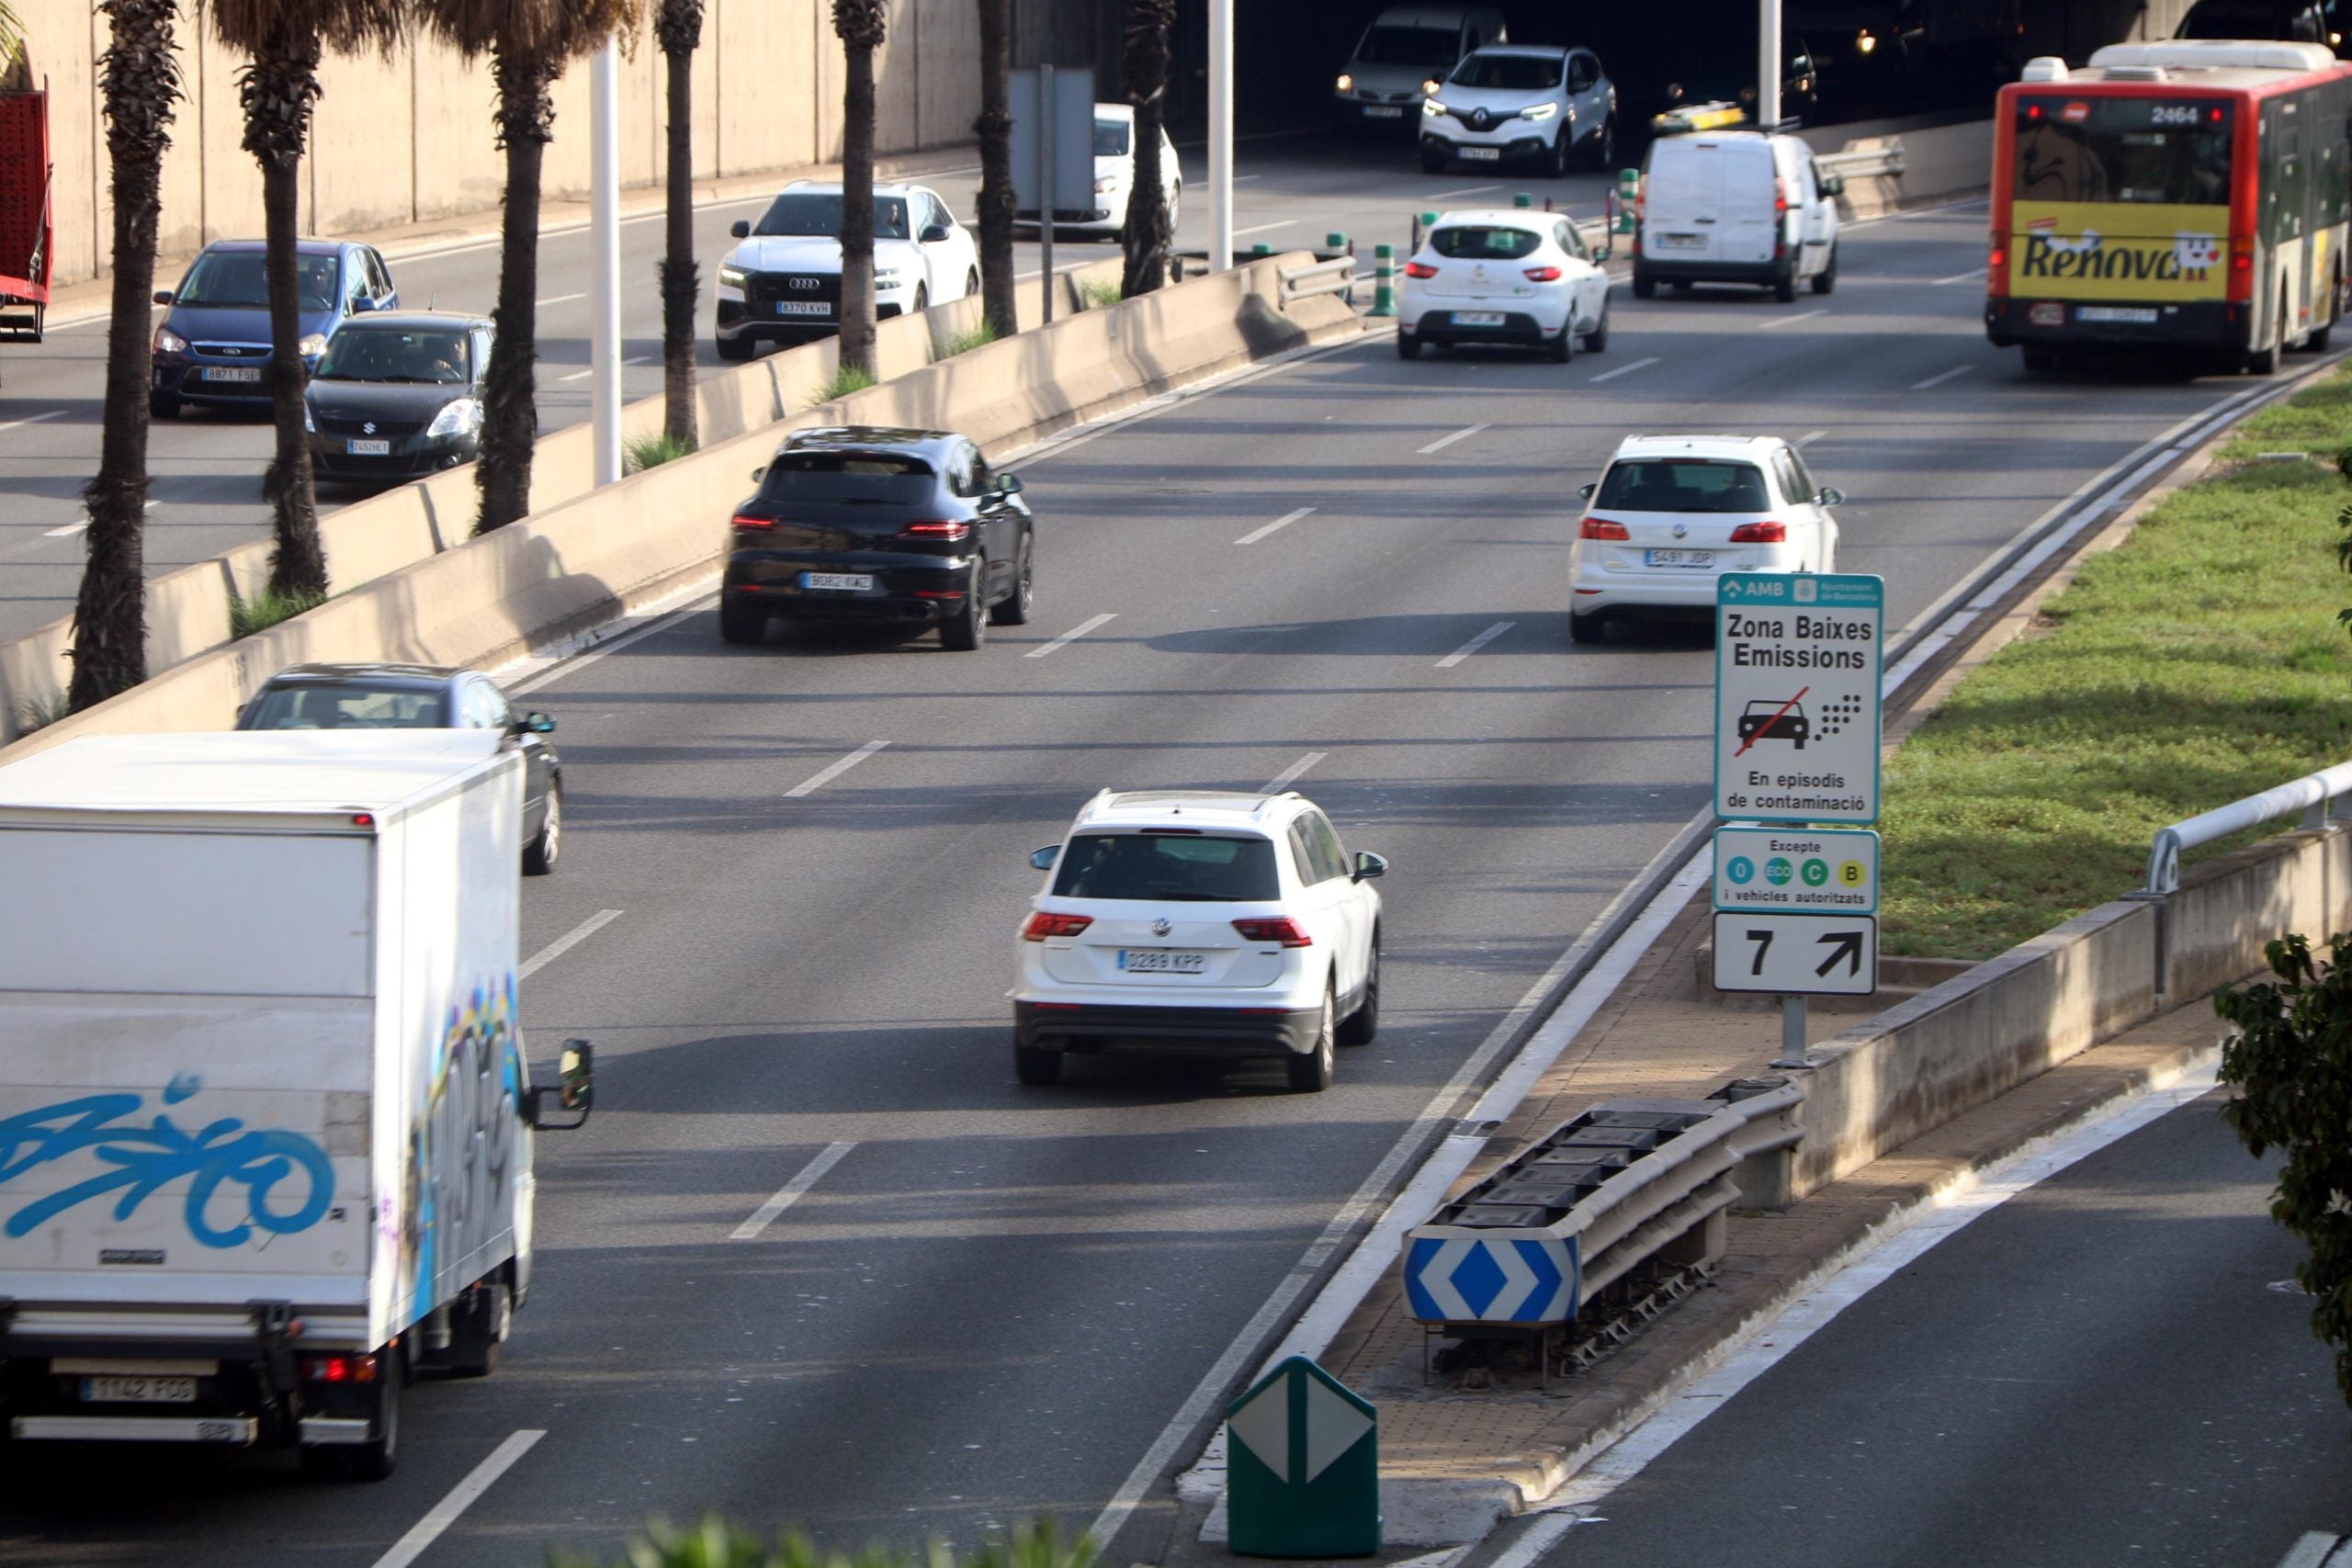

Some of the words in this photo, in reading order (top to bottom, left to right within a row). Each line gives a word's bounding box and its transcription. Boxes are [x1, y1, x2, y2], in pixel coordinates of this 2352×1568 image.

[2151, 107, 2199, 124] 2464
[2023, 235, 2180, 279] Renova
[1746, 582, 1784, 596] AMB
[1728, 614, 1783, 638] Zona
[1796, 615, 1871, 640] Baixes
[1735, 643, 1865, 669] Emissions
[1748, 771, 1770, 786] En
[1777, 772, 1845, 789] episodis
[1728, 793, 1747, 807] de
[1756, 795, 1865, 811] contaminació
[1770, 840, 1822, 854] Excepte
[1767, 865, 1792, 877] ECO
[1807, 864, 1822, 881] C
[1845, 866, 1859, 881] B
[1736, 890, 1789, 902] vehicles
[1795, 893, 1865, 905] autoritzats
[1747, 930, 1774, 976] 7
